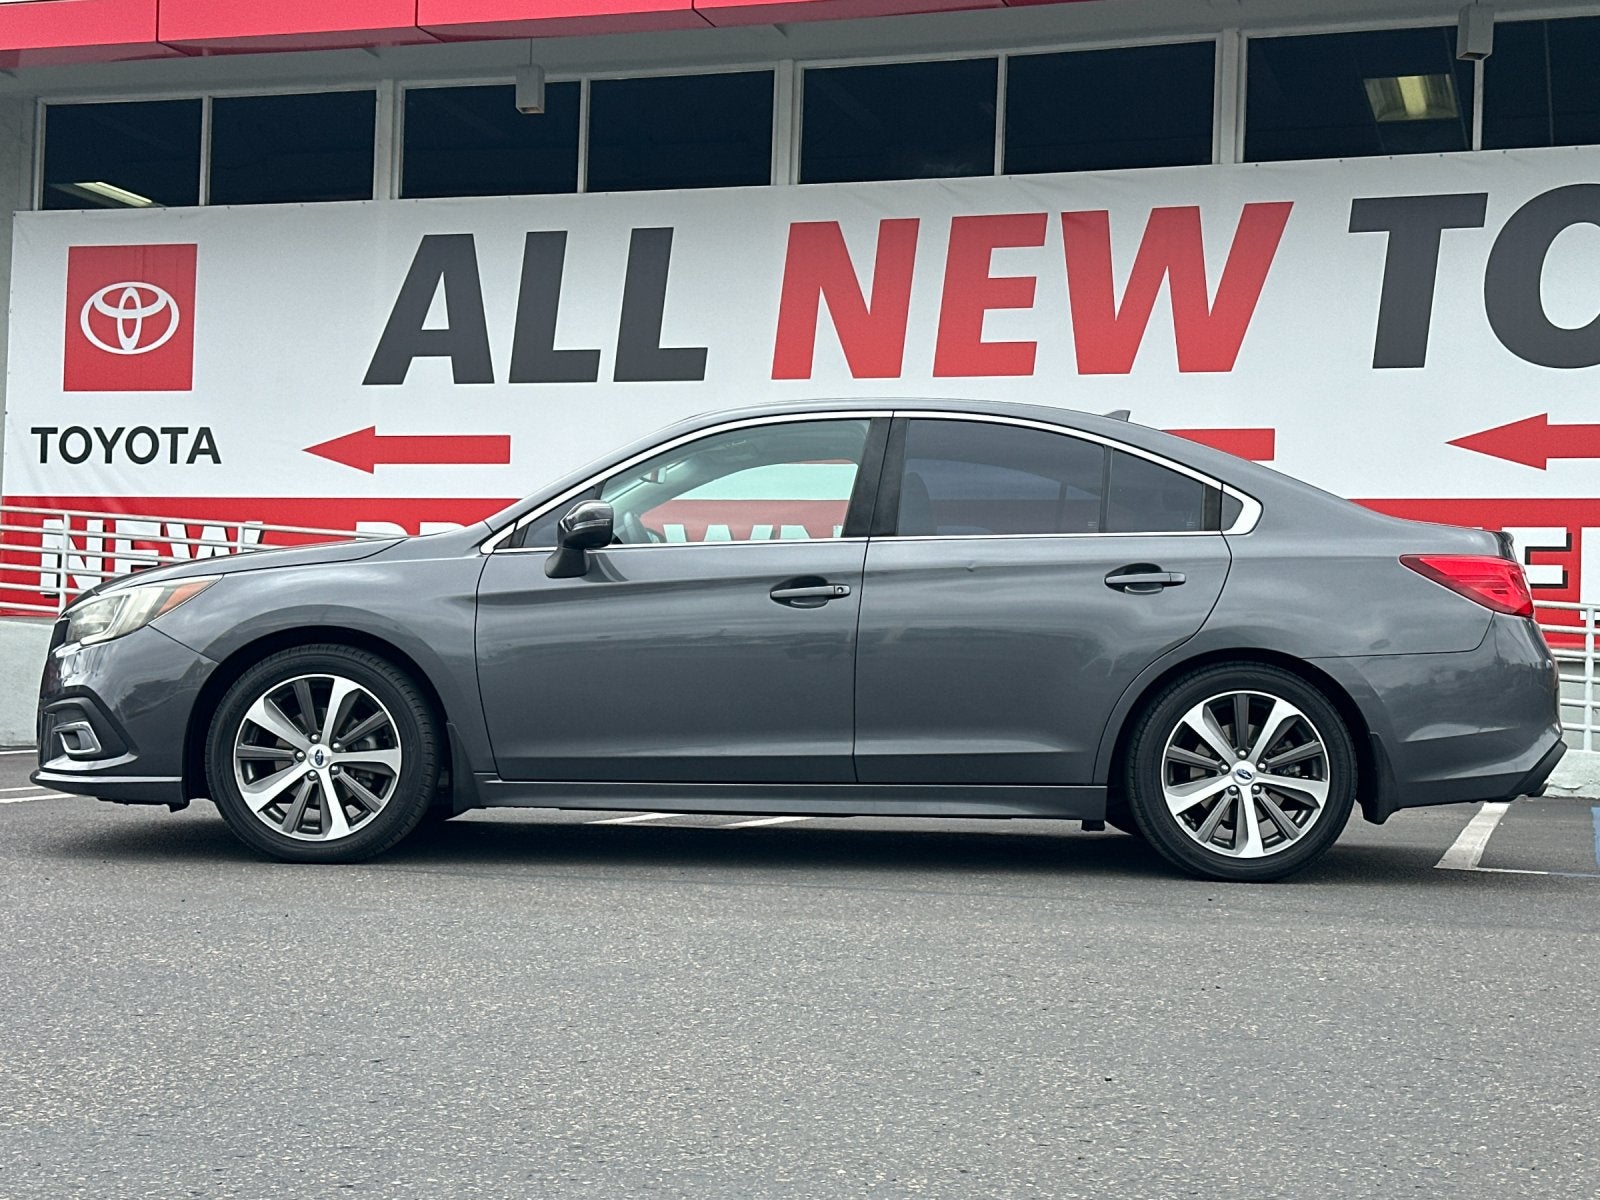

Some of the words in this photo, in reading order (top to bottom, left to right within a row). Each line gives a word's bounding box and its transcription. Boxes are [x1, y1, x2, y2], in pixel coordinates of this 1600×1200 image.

[362, 227, 708, 385] ALL
[771, 202, 1294, 379] NEW
[31, 426, 222, 464] TOYOTA
